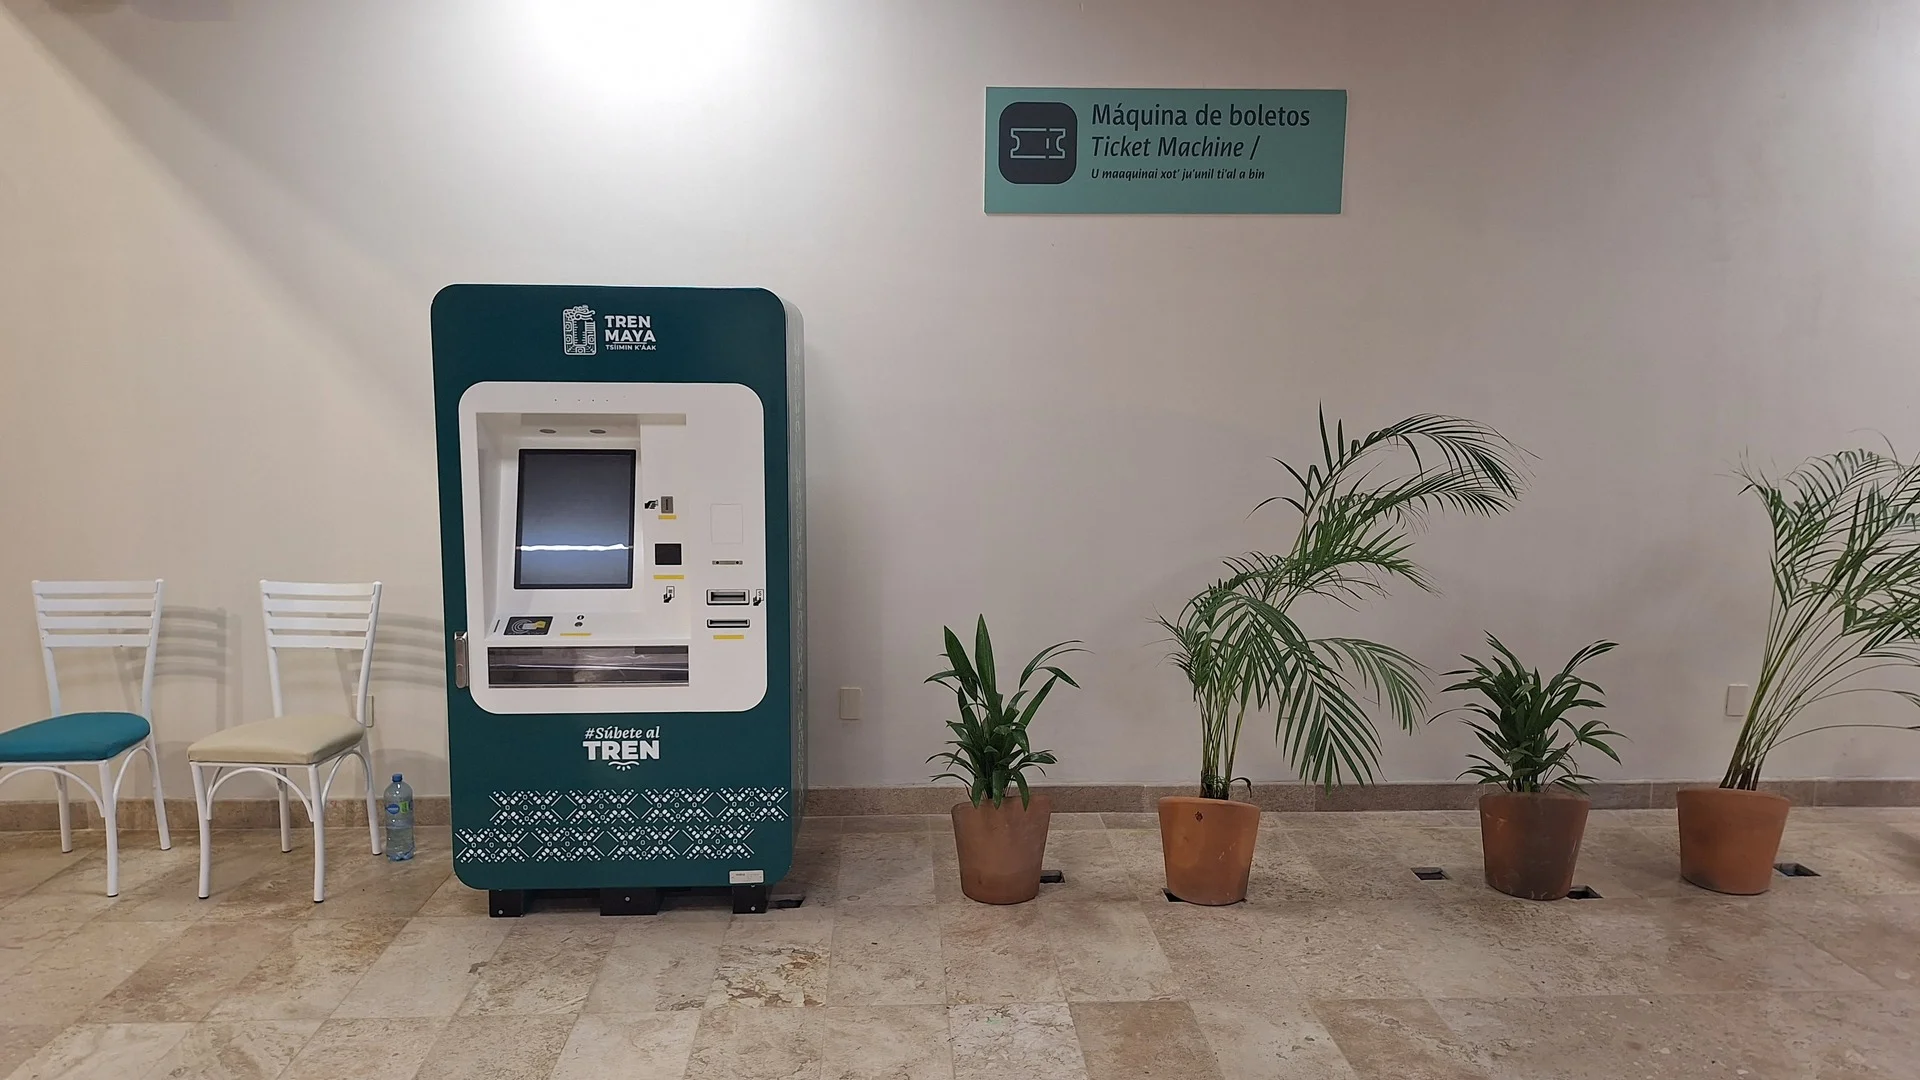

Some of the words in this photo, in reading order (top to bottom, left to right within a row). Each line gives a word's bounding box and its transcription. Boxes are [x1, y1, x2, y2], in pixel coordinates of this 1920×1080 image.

[1092, 102, 1187, 131] Máquina
[1195, 103, 1222, 126] de
[1229, 103, 1310, 126] boletos
[1091, 135, 1151, 157] Ticket
[1157, 135, 1244, 157] Machine
[1091, 168, 1099, 179] U
[1101, 168, 1158, 181] maaquinai
[1239, 170, 1246, 179] a
[1248, 168, 1265, 179] bin
[604, 315, 651, 328] TREN
[604, 329, 657, 342] MAYA
[584, 726, 643, 739] #Súbete
[645, 726, 660, 739] al
[582, 740, 660, 760] TREN
